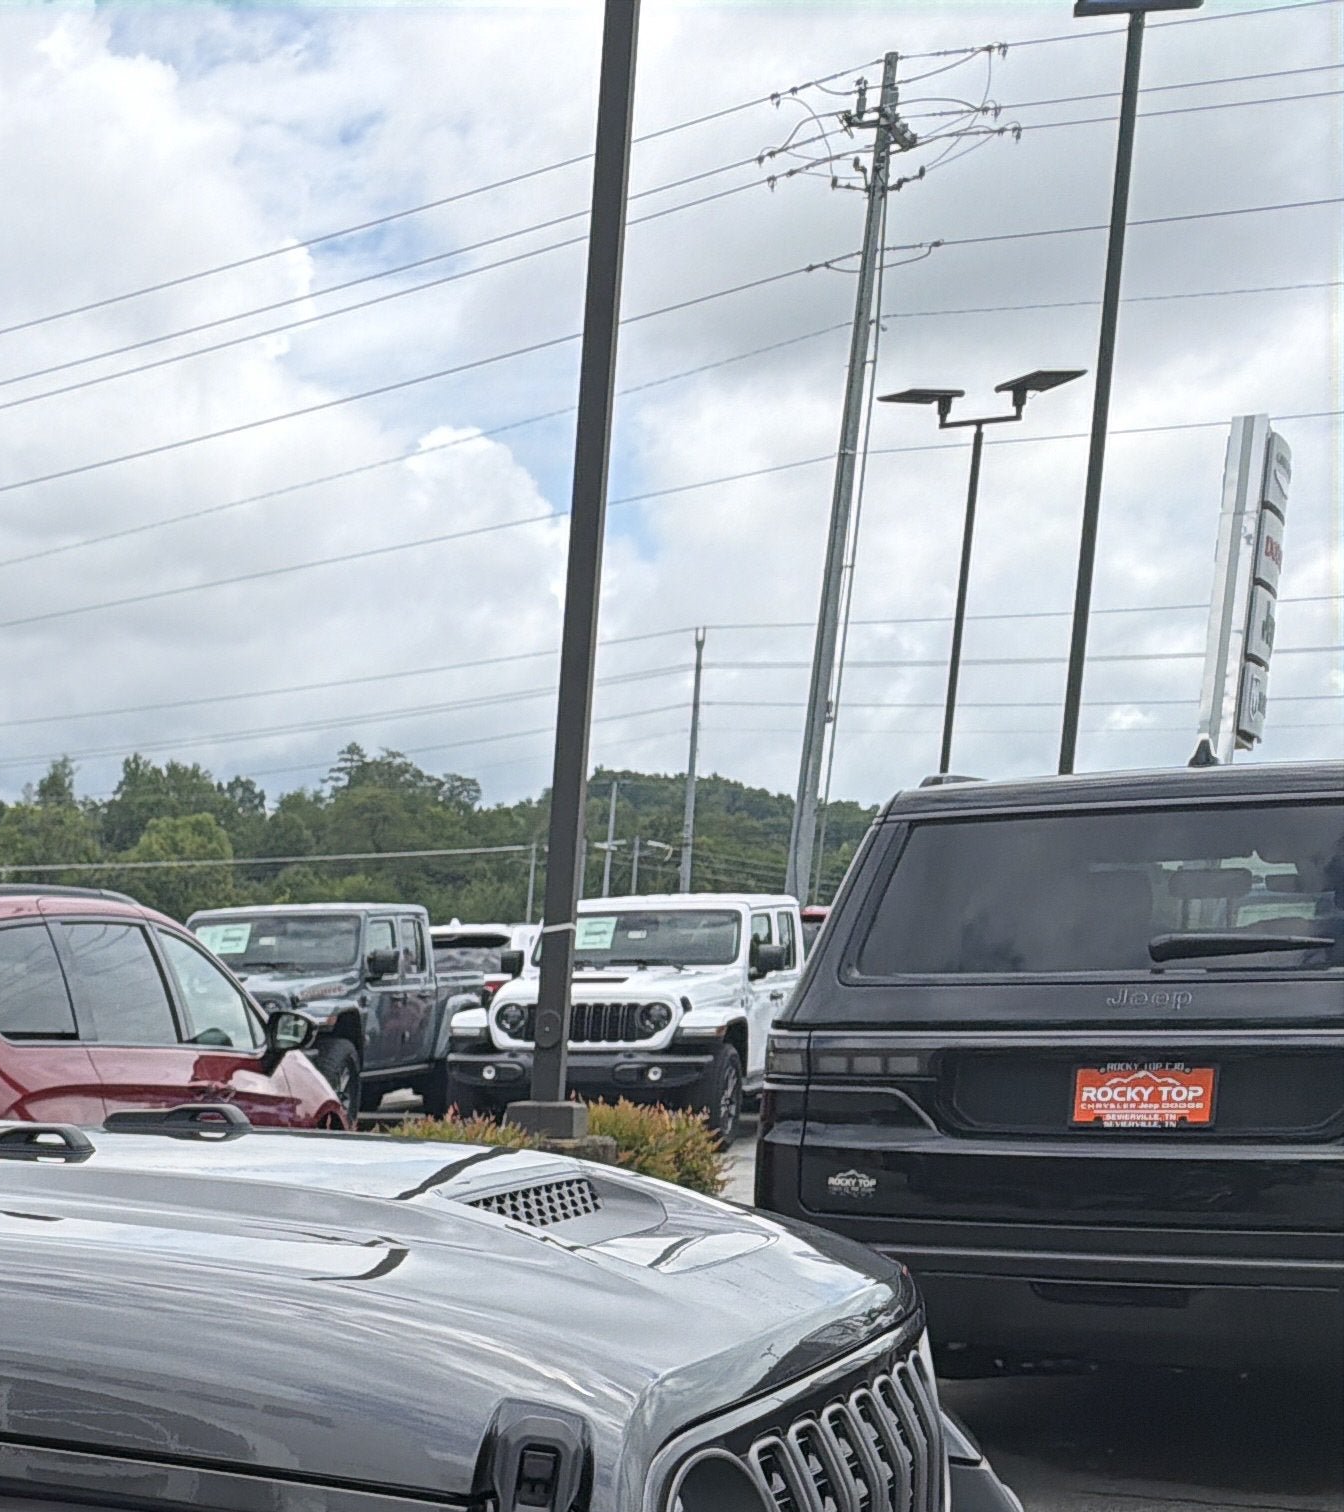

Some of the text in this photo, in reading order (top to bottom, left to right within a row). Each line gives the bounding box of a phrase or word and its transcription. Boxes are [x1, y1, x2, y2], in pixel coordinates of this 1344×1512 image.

[1106, 988, 1193, 1010] Jeep
[1081, 1086, 1204, 1102] ROCKY TOP
[827, 1176, 877, 1188] ROCKY TOP
